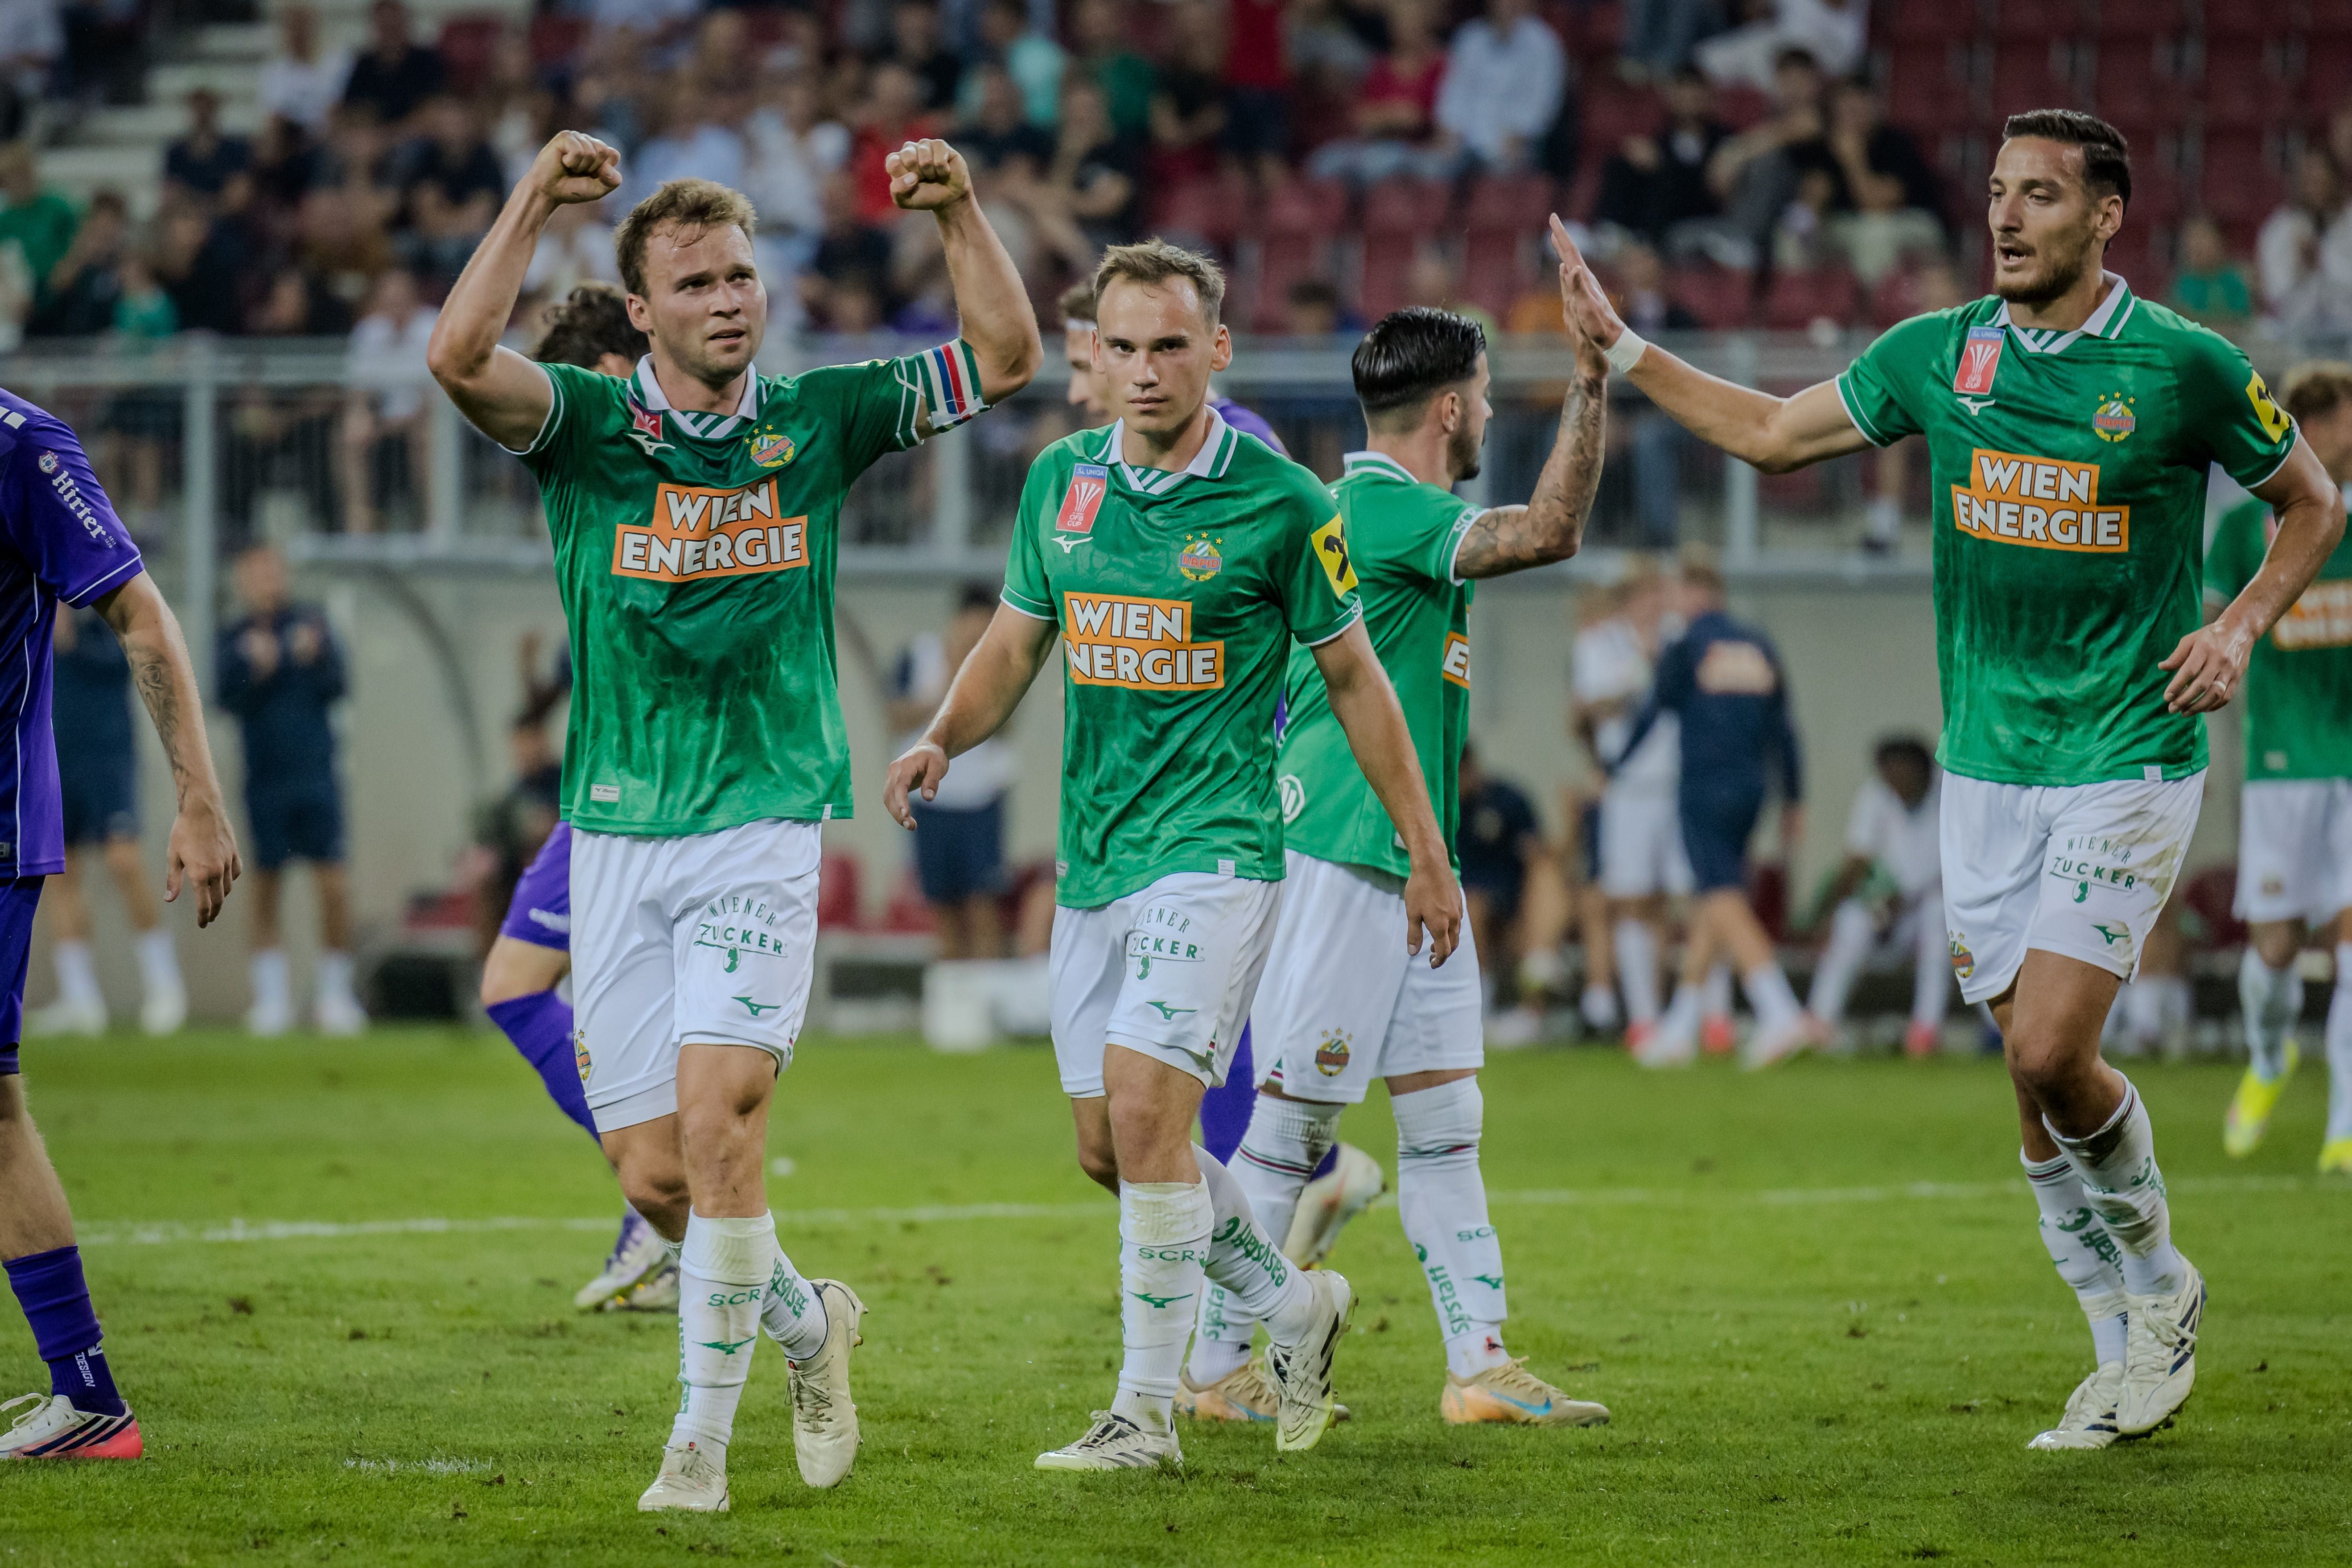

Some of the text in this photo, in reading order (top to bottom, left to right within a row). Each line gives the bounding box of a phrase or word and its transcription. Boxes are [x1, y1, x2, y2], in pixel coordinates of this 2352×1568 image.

[2097, 416, 2133, 428] RAPID
[756, 439, 790, 463] RAPID
[1979, 455, 2091, 504] WIEN
[52, 470, 106, 539] Hirter
[665, 482, 773, 532] WIEN
[1956, 492, 2121, 546] ENERGIE
[620, 523, 802, 576] ENERGIE
[1182, 555, 1219, 568] RAPID
[1069, 599, 1183, 643] WIEN
[1065, 638, 1216, 684] NERGIE
[2068, 836, 2131, 864] WIENER
[2049, 856, 2135, 890] ZUCKER
[707, 897, 777, 926] WIENER
[694, 923, 783, 954] ZUCKER
[1138, 1247, 1196, 1262] SCR
[1231, 1222, 1288, 1287] easystaff
[707, 1288, 760, 1307] SCR
[74, 1351, 95, 1387] DESIGN
